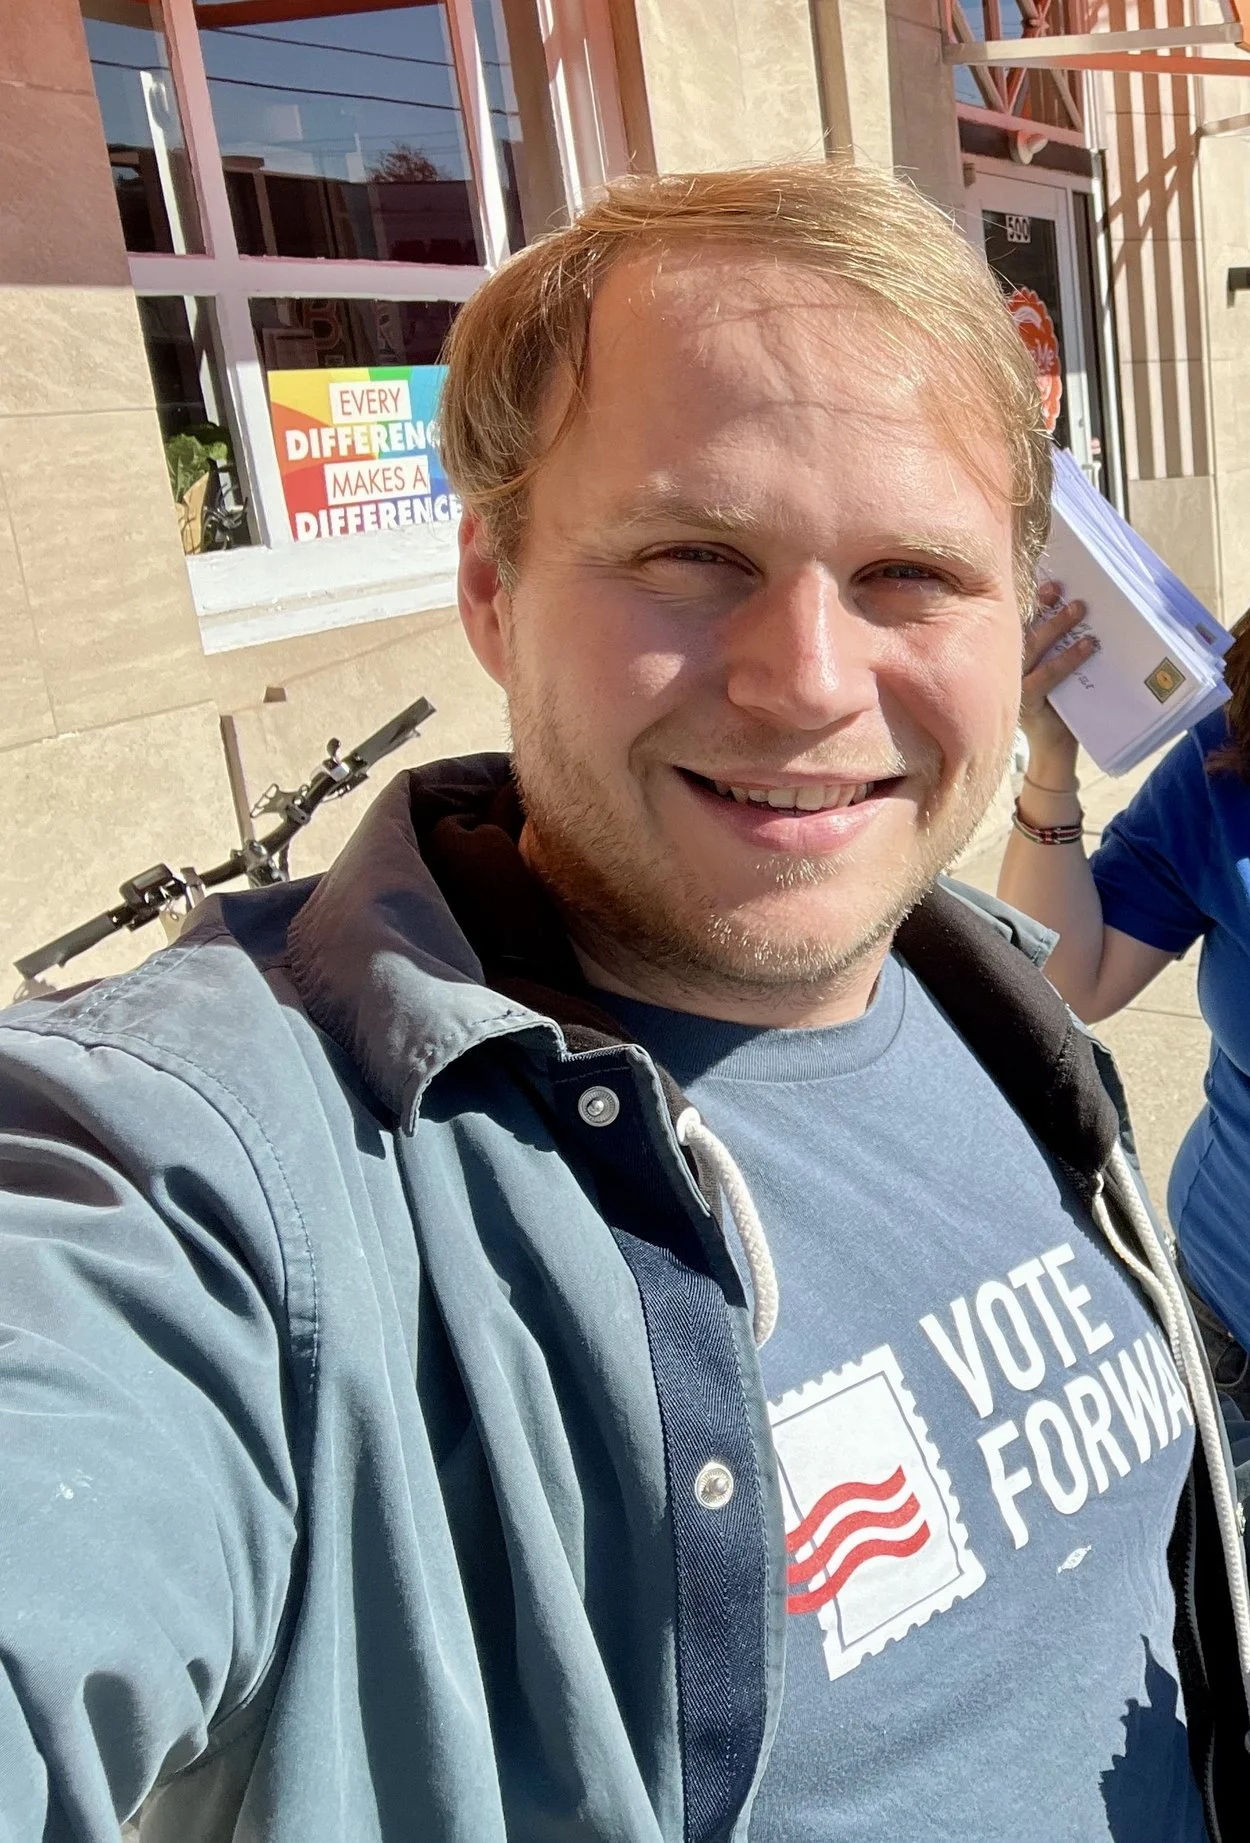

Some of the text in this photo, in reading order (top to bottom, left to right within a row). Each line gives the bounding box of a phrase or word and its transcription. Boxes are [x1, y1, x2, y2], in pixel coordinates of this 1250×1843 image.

[1008, 216, 1030, 240] 500
[339, 387, 401, 416] EVERY
[285, 420, 441, 461] DIFFERENC
[333, 464, 427, 499] MAKES A
[295, 494, 463, 542] DIFFERENCE
[919, 1243, 1114, 1419] VOTE
[977, 1332, 1194, 1550] FORWA
